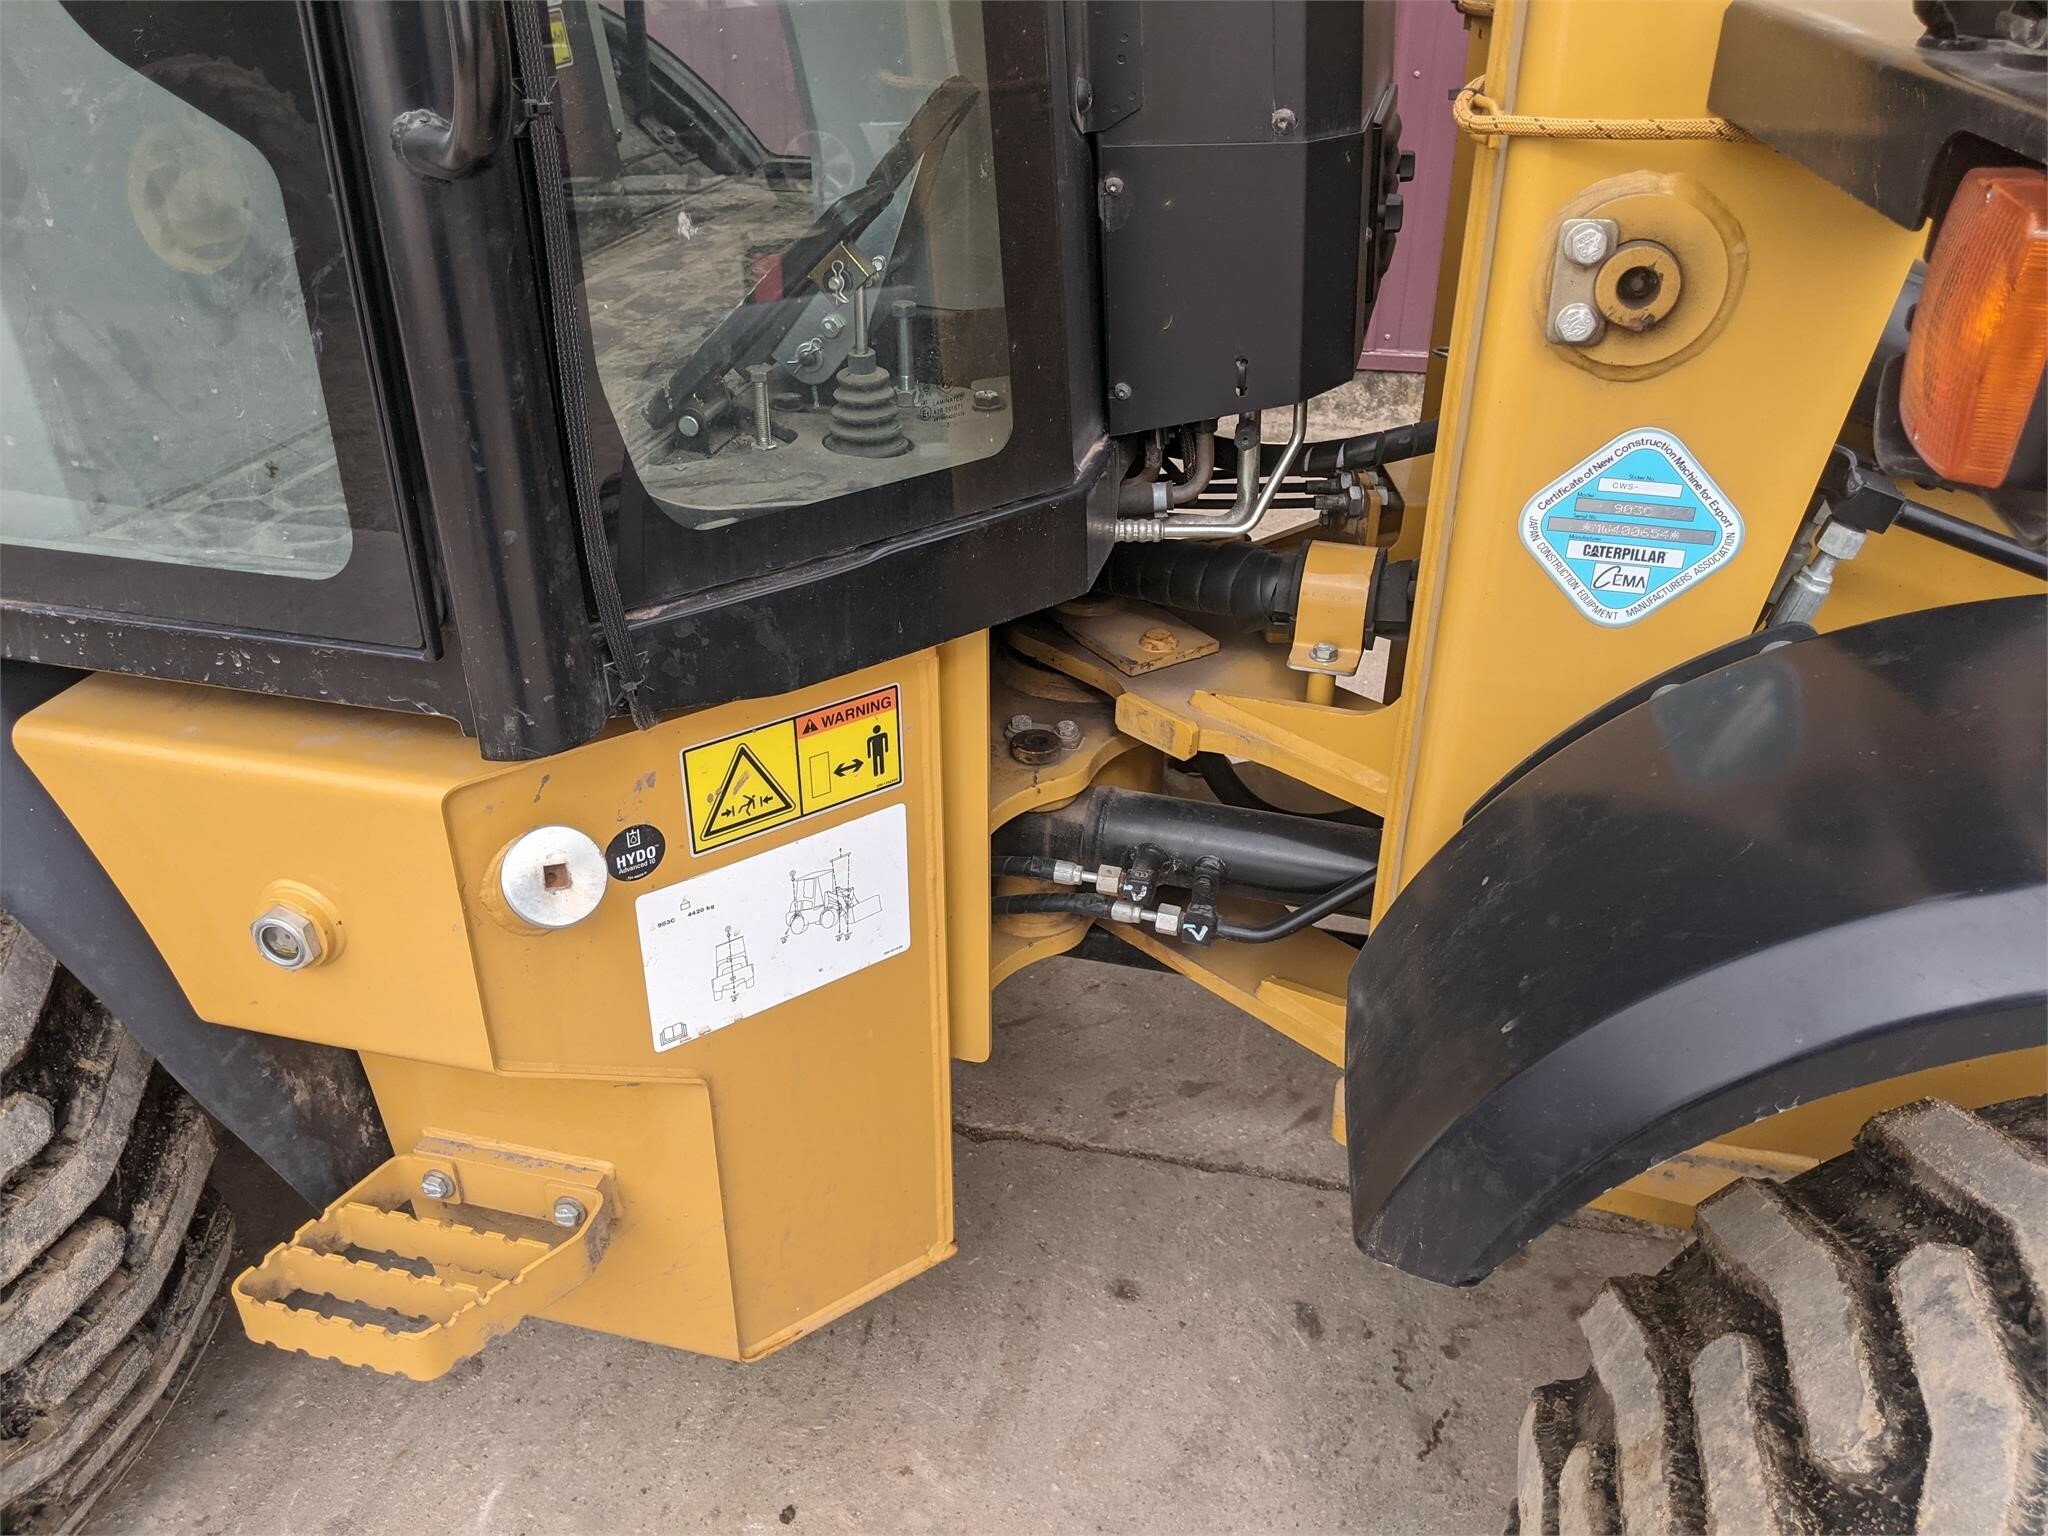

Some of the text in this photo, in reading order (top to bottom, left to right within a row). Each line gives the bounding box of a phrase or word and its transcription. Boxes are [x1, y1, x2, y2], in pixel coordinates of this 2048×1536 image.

[1538, 438, 1734, 528] Certificate of New Construction Machine for Export
[1612, 482, 1639, 491] CWS-
[1614, 504, 1654, 517] 903C
[1583, 544, 1667, 564] CATERPILLAR
[1529, 515, 1736, 620] JAPAN CONSTRUCTION EQUIPMENT MANUFACTURERS ASSOCIATION
[1593, 565, 1646, 589] CEMA
[821, 696, 892, 729] WARNING
[616, 846, 657, 869] HYDO
[618, 860, 648, 875] Advanced
[687, 903, 716, 918] 4420 kg
[657, 917, 676, 928] 903C
